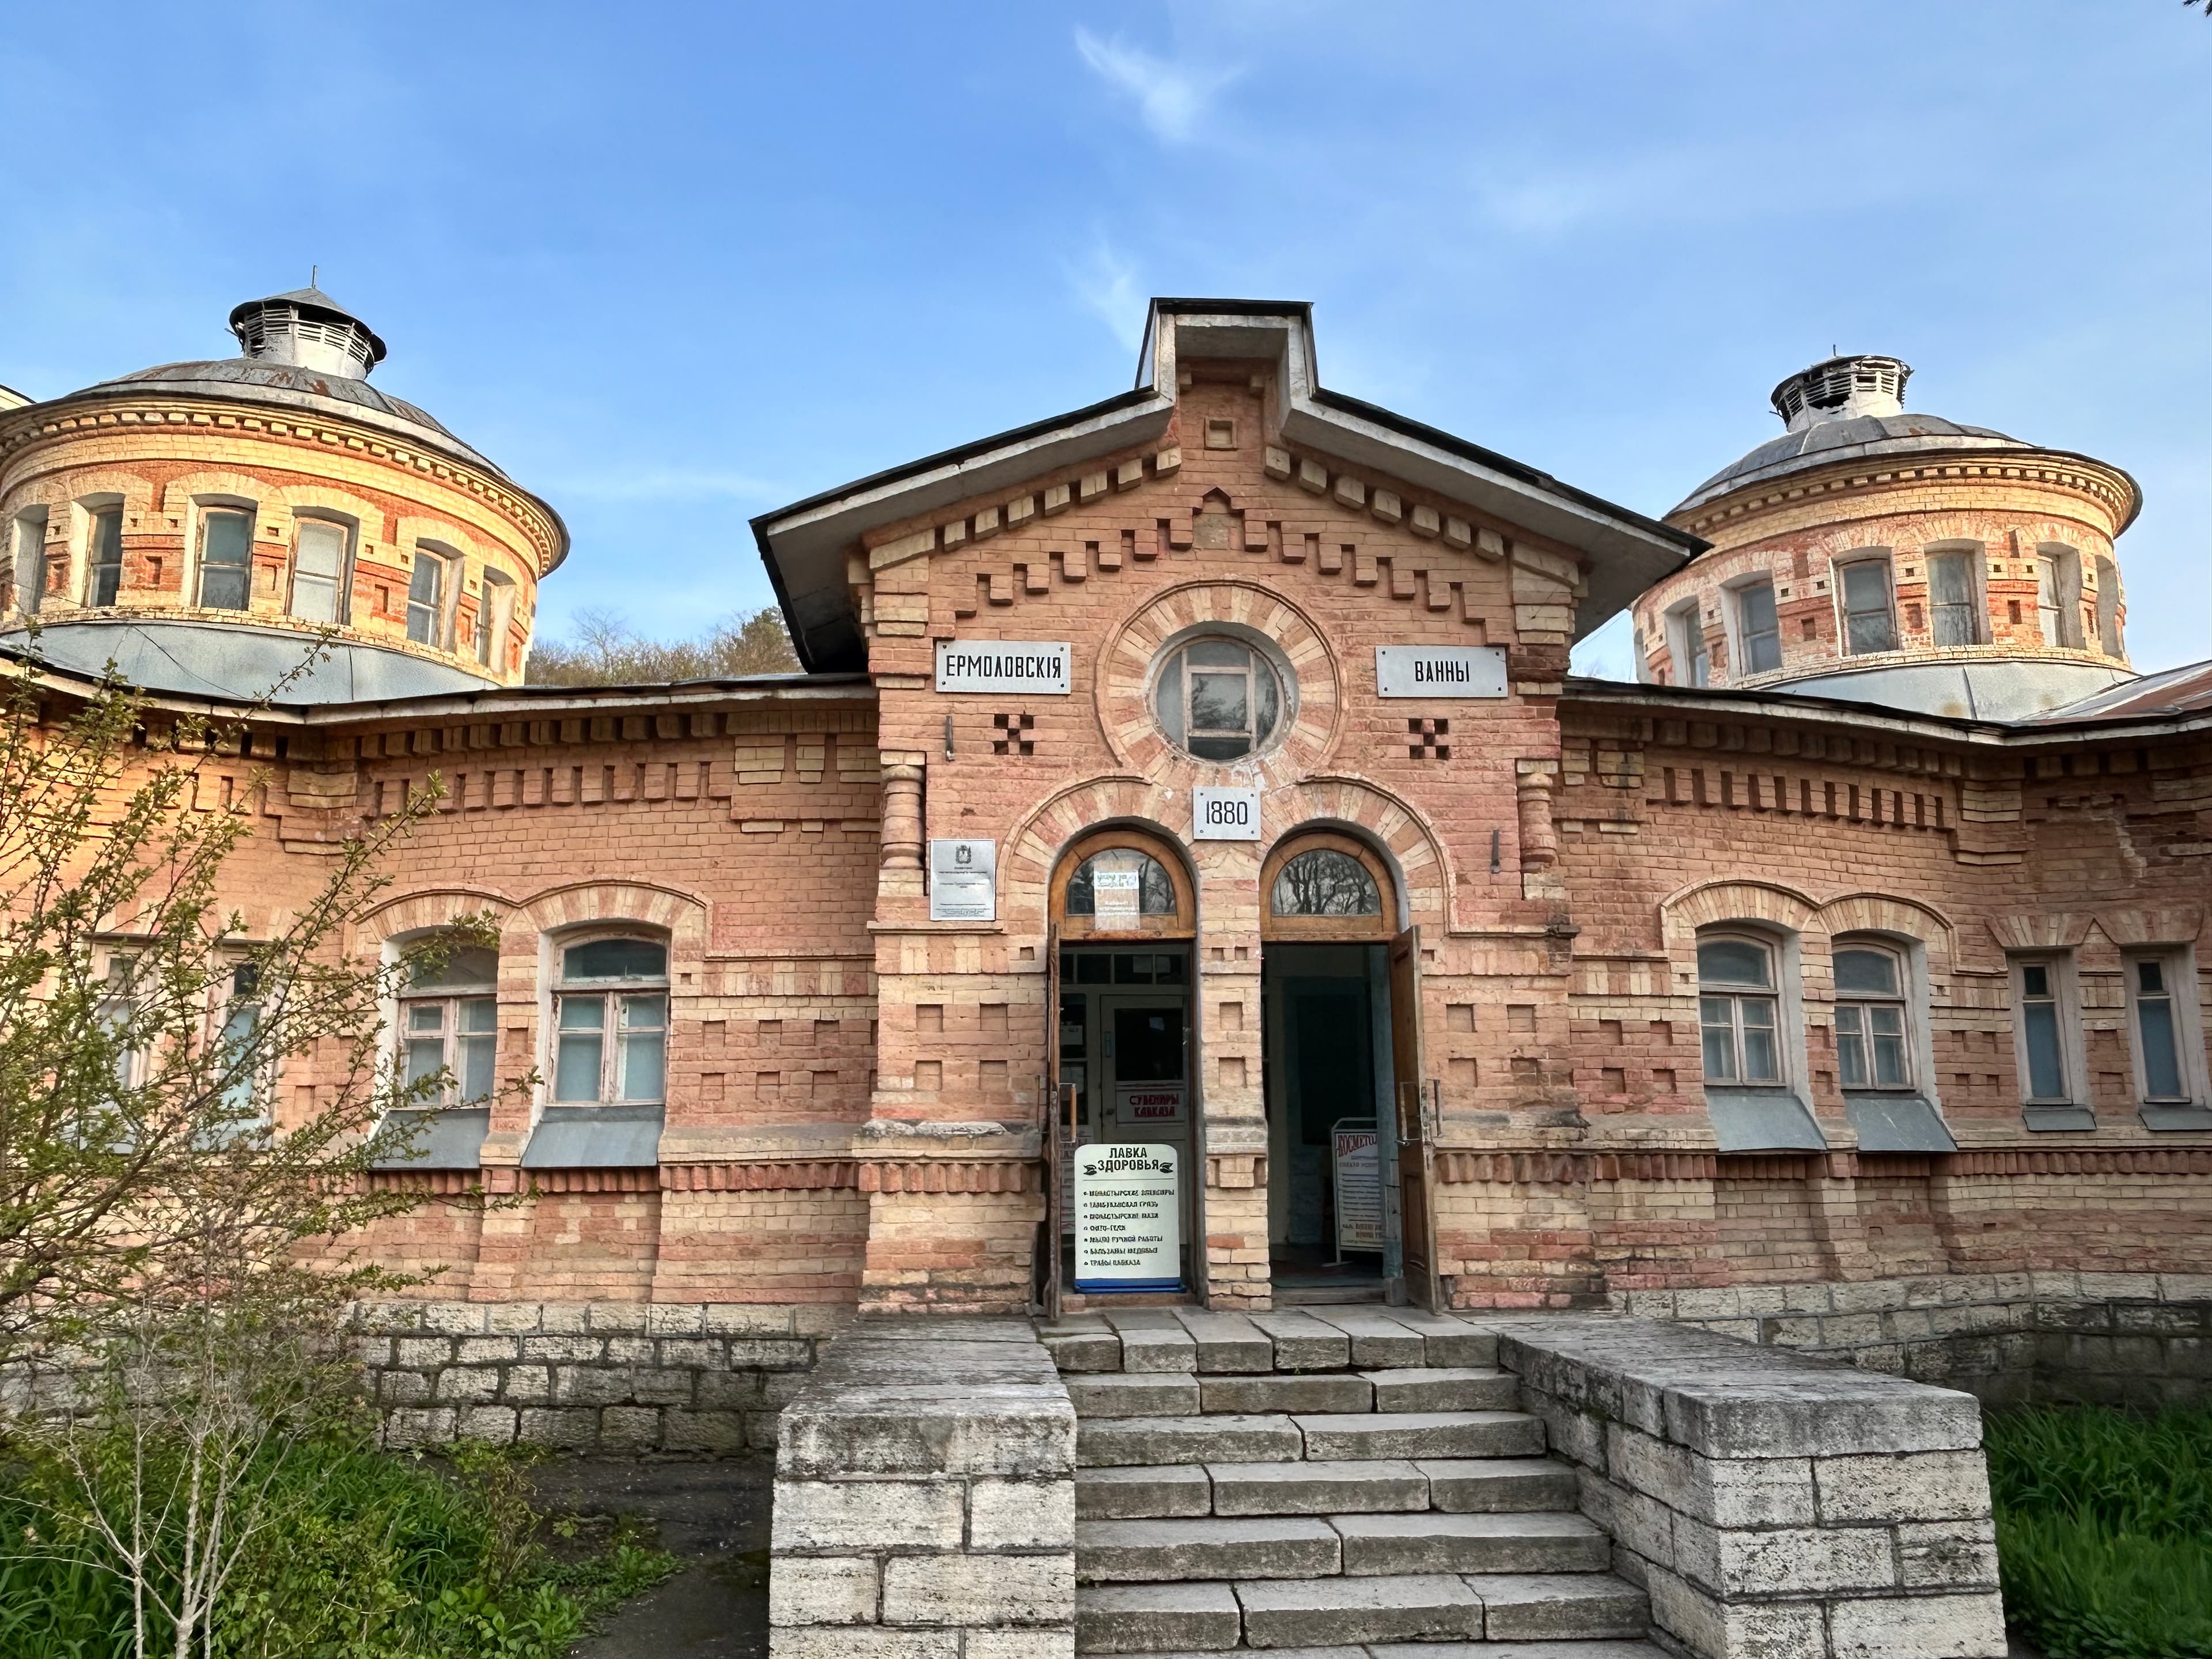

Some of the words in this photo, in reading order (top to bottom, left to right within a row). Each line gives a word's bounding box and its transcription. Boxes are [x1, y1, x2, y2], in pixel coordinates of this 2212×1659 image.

[946, 655, 1061, 678] ЕРМОЛОВСКІЯ
[1415, 661, 1469, 682] ВАННЫ
[1206, 801, 1248, 825] 1880
[1109, 1147, 1147, 1158] ЛАВКА
[1098, 1160, 1159, 1172] ЗДОРОВЬЯ
